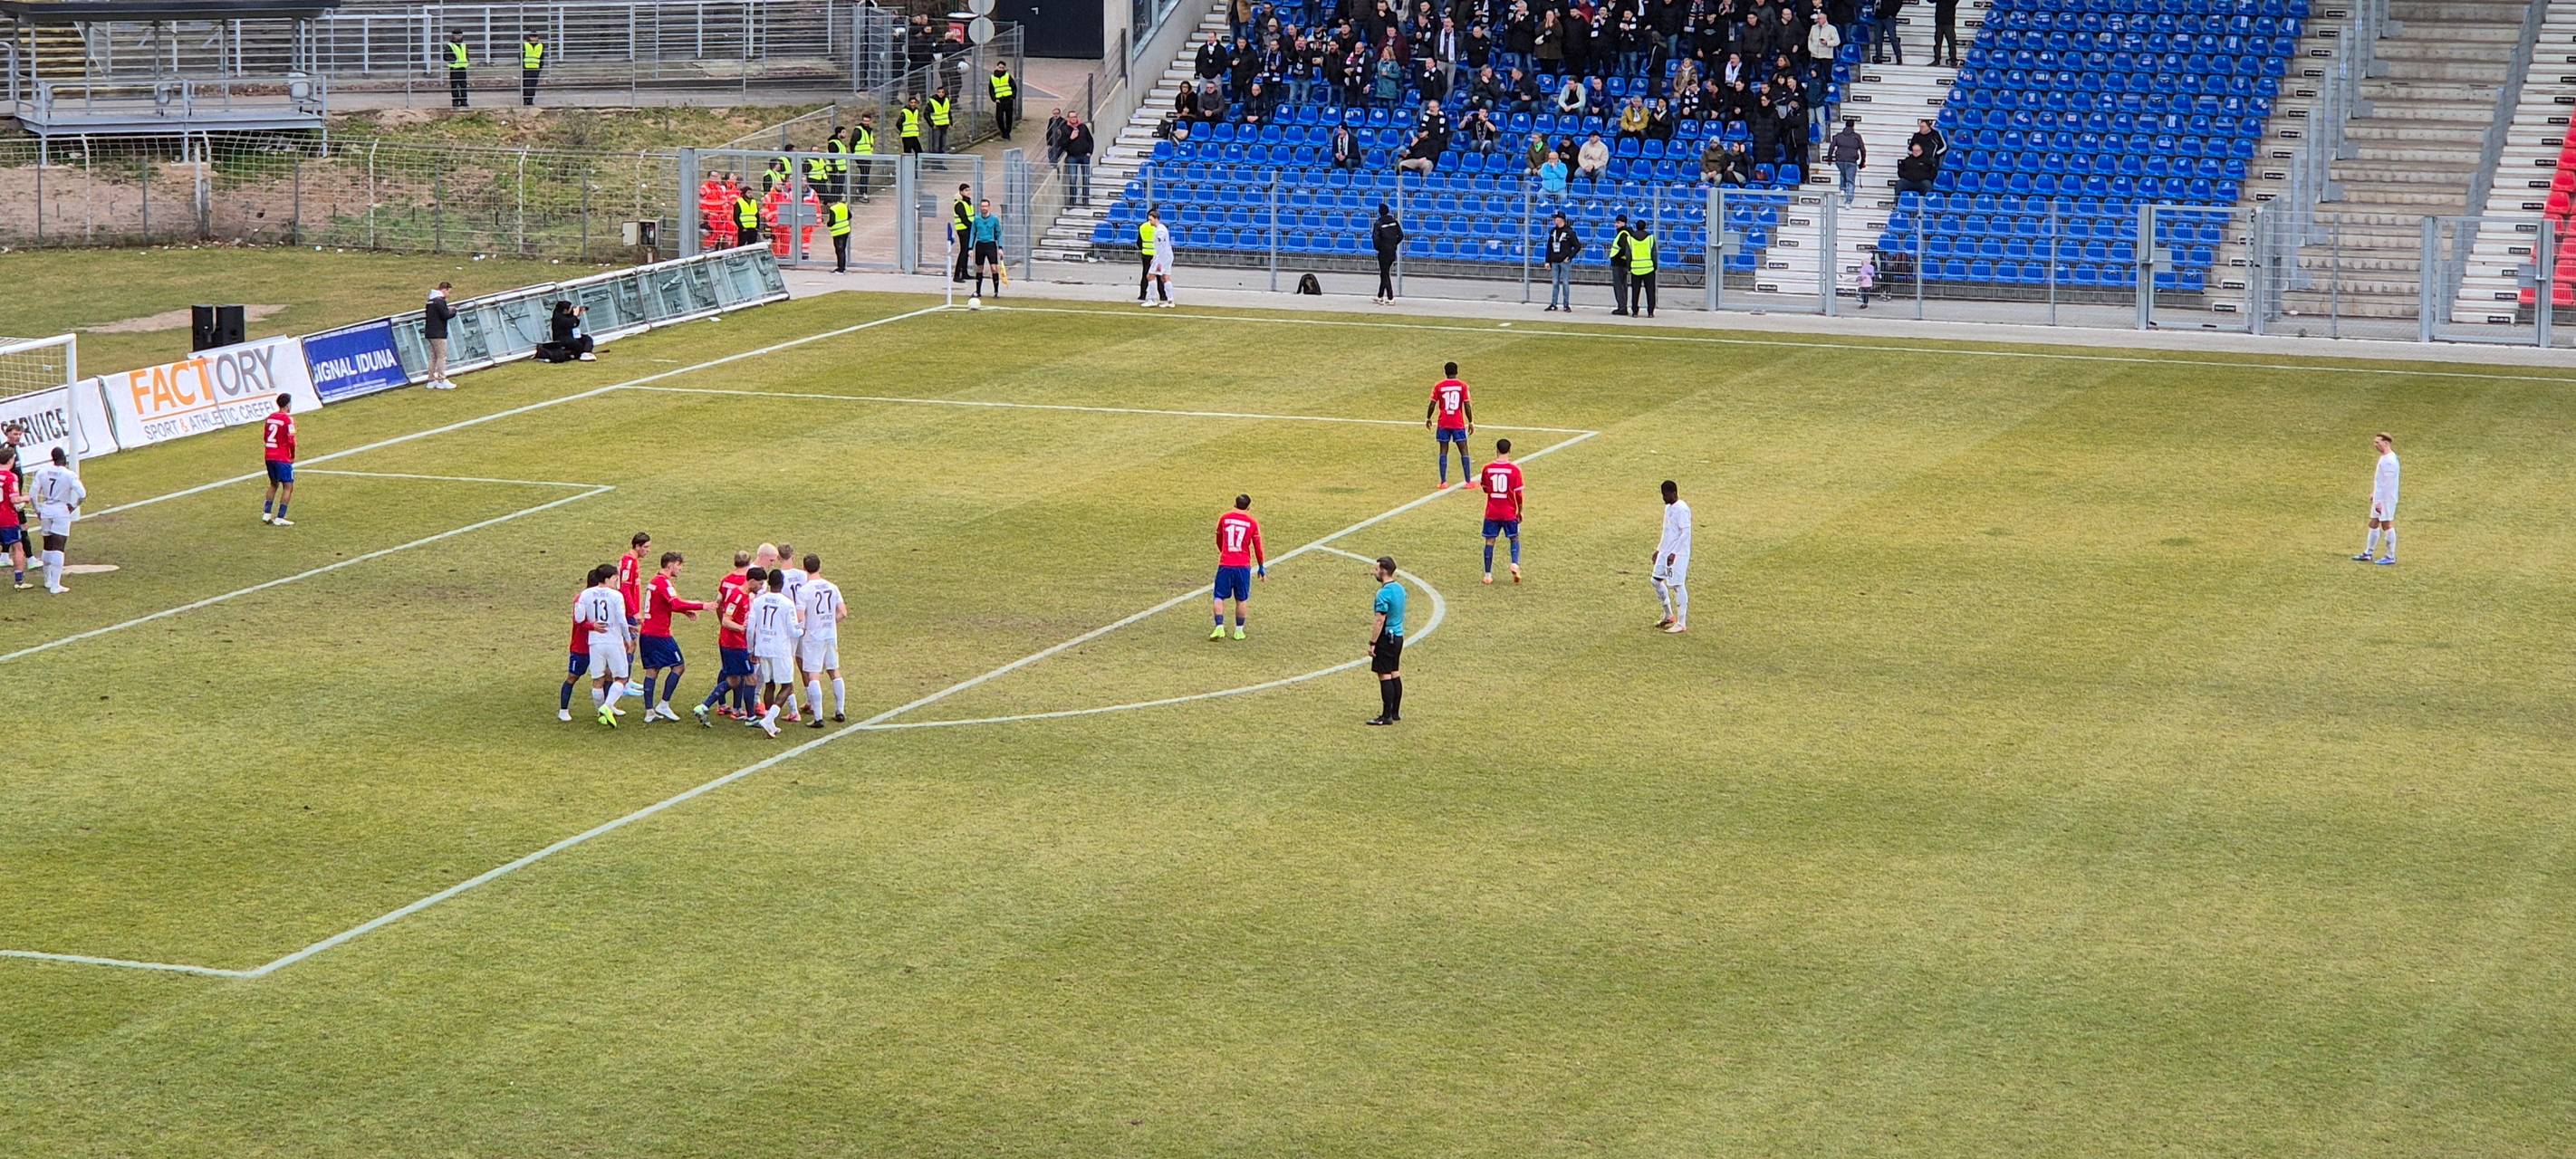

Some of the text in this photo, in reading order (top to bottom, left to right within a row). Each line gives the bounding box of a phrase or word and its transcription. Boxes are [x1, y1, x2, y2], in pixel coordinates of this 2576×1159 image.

[355, 349, 398, 374] IDUNA
[130, 345, 276, 415] FACTORY
[1442, 391, 1460, 411] 19
[144, 419, 179, 440] SPORT
[189, 407, 239, 432] ATHLETIC
[267, 424, 278, 443] 2
[49, 478, 56, 496] 7
[1490, 474, 1507, 493] 10
[1225, 525, 1246, 548] 17
[593, 599, 609, 622] 13
[815, 589, 832, 615] 27
[763, 605, 778, 629] 17
